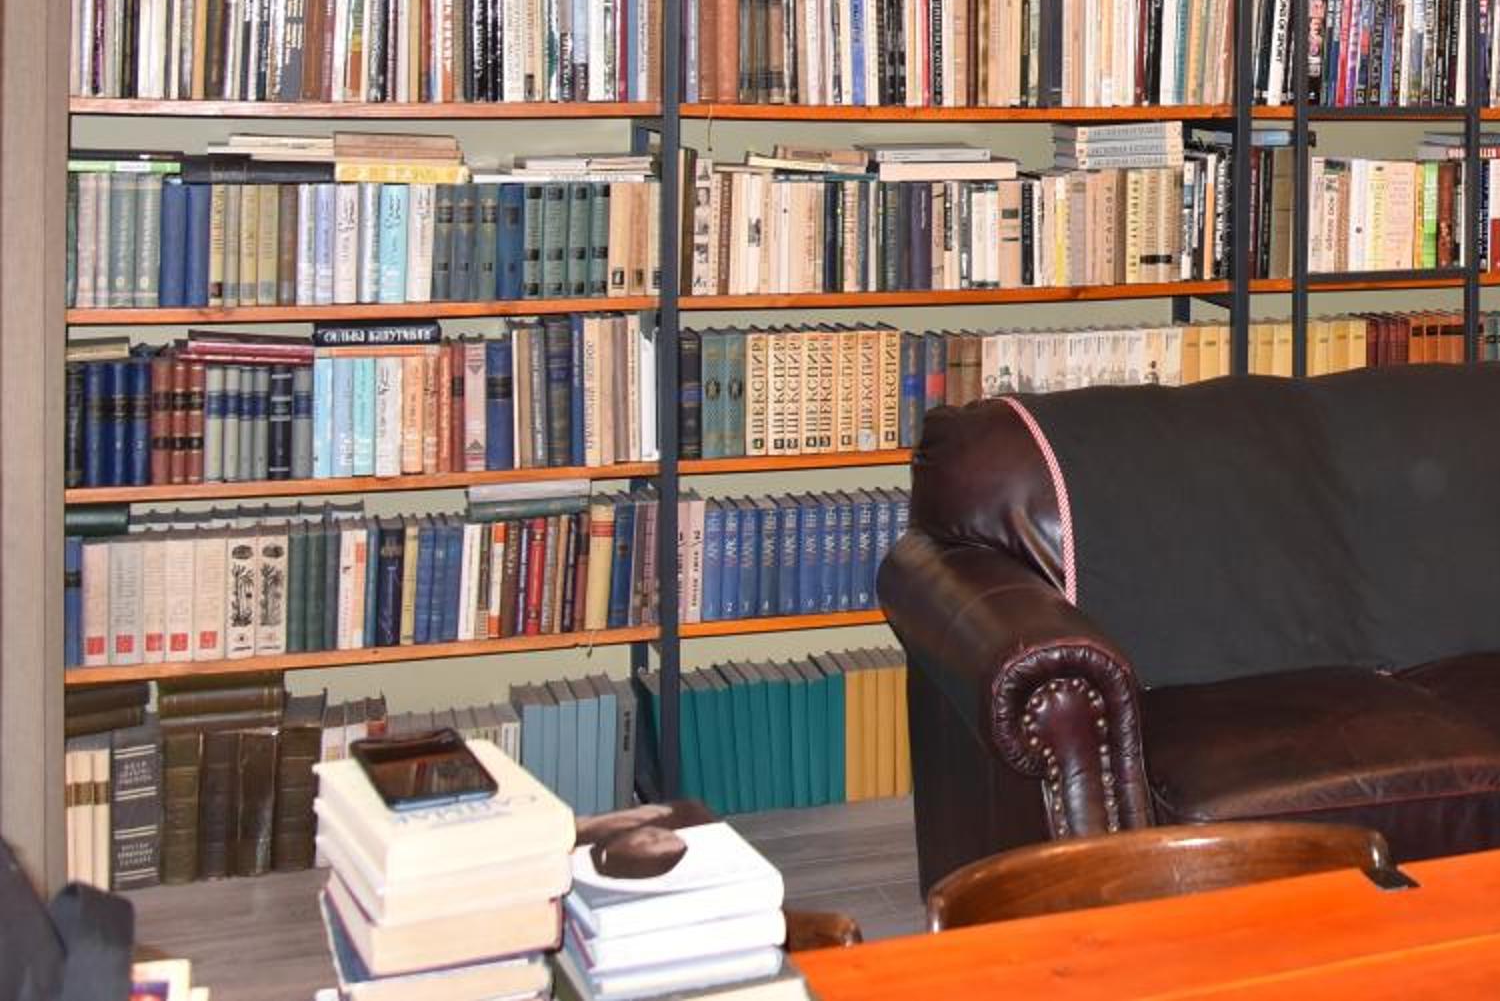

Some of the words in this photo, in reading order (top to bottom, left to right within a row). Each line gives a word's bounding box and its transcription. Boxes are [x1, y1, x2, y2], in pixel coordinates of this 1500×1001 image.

[1275, 32, 1285, 63] SPORT
[752, 343, 764, 434] ШЕКСПИР
[774, 343, 784, 434] ШЕКСПИР
[787, 343, 800, 434] ШЕКСПИР
[807, 342, 818, 432] ШЕКСПИР
[820, 342, 832, 432] ШЕКСПИР
[841, 342, 853, 431] ШЕКСПИР
[862, 342, 873, 429] ШЕКСПИР
[884, 338, 896, 428] ШЕКСПИР
